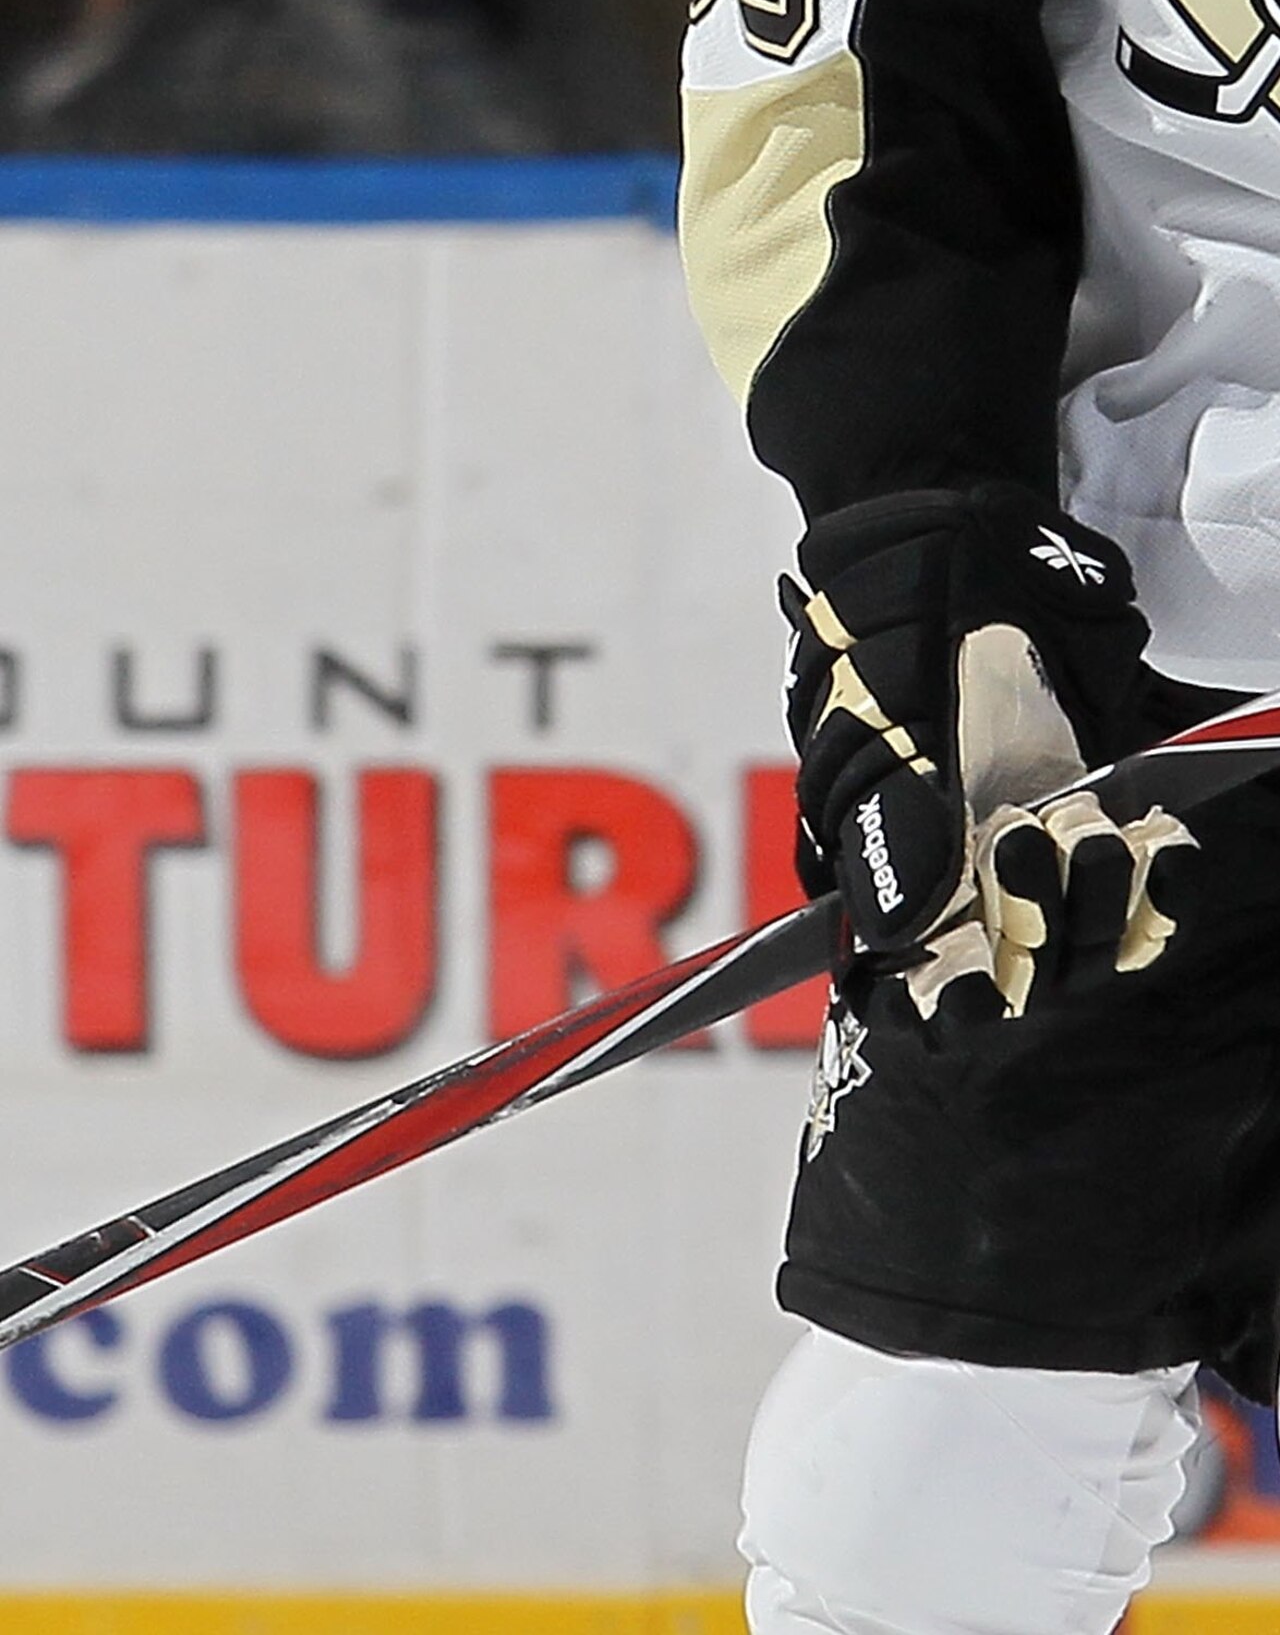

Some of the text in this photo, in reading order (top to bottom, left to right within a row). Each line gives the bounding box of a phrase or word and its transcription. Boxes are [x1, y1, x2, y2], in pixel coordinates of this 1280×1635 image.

[0, 640, 596, 732] UNT
[856, 792, 905, 914] Reebok
[4, 1301, 556, 1424] com
